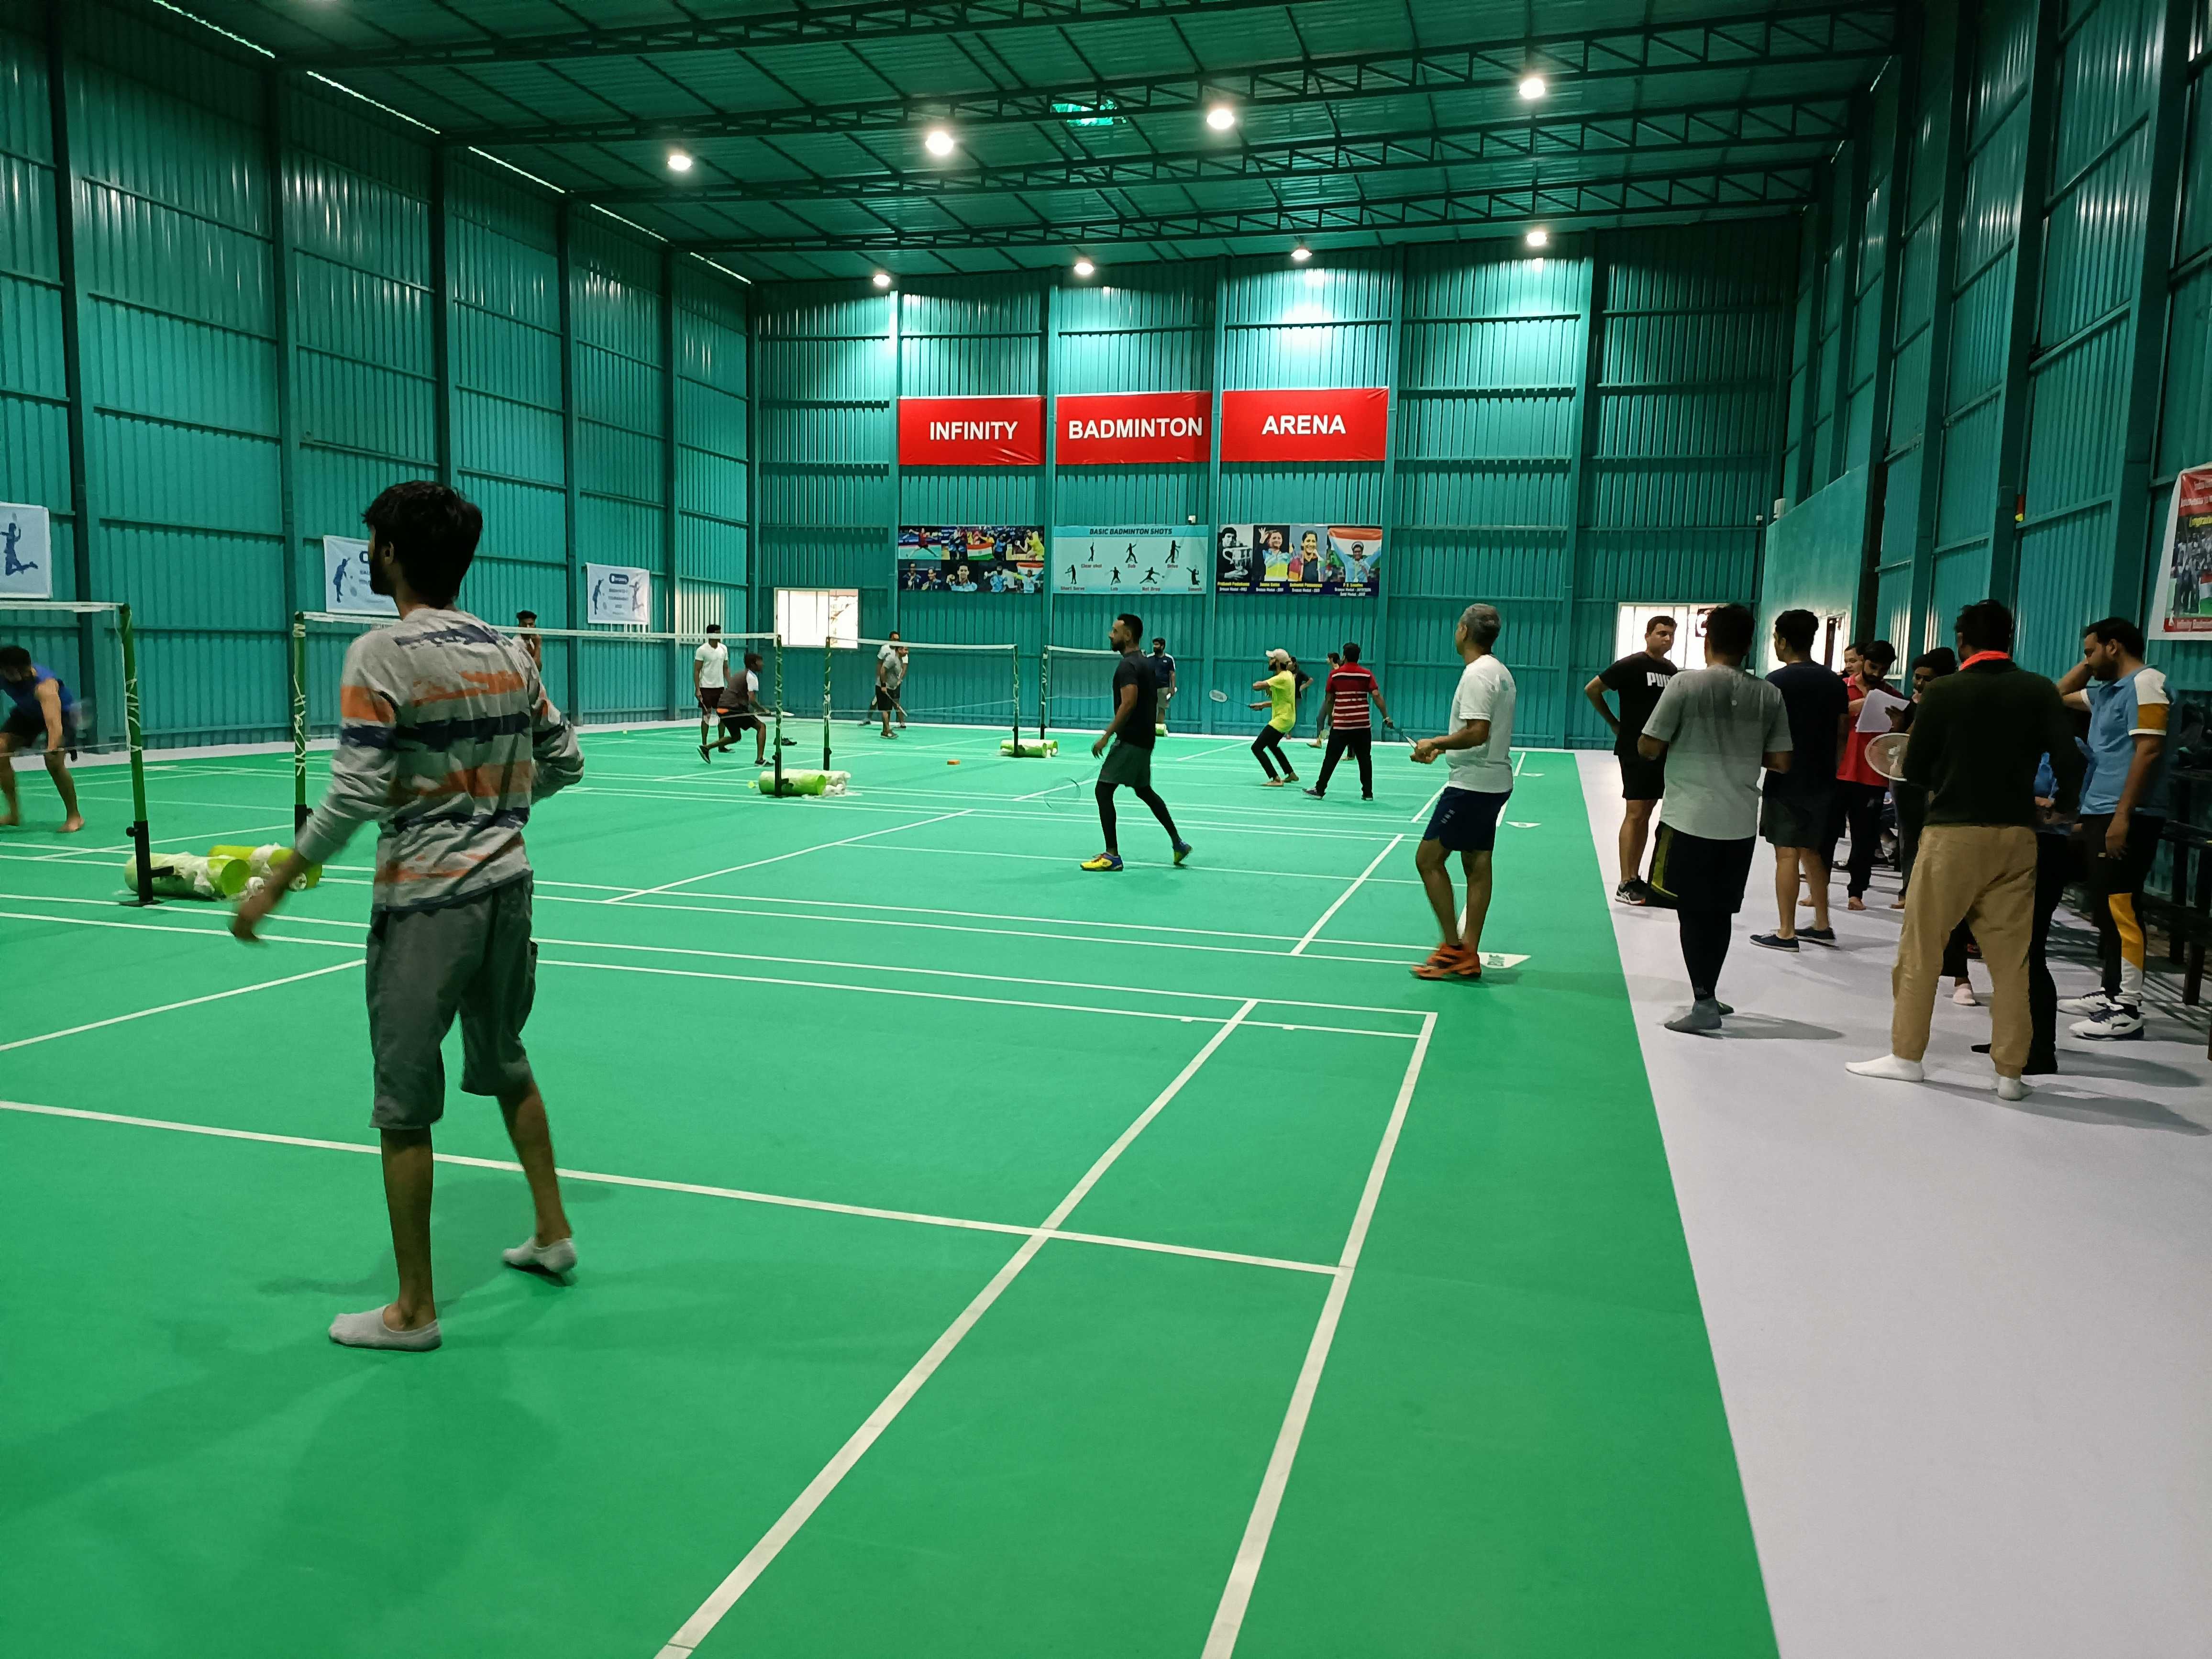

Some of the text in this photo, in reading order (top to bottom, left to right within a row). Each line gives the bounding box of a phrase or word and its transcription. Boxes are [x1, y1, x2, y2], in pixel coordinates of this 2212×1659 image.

[930, 414, 1346, 440] INFINITY BADMINTON ARENA
